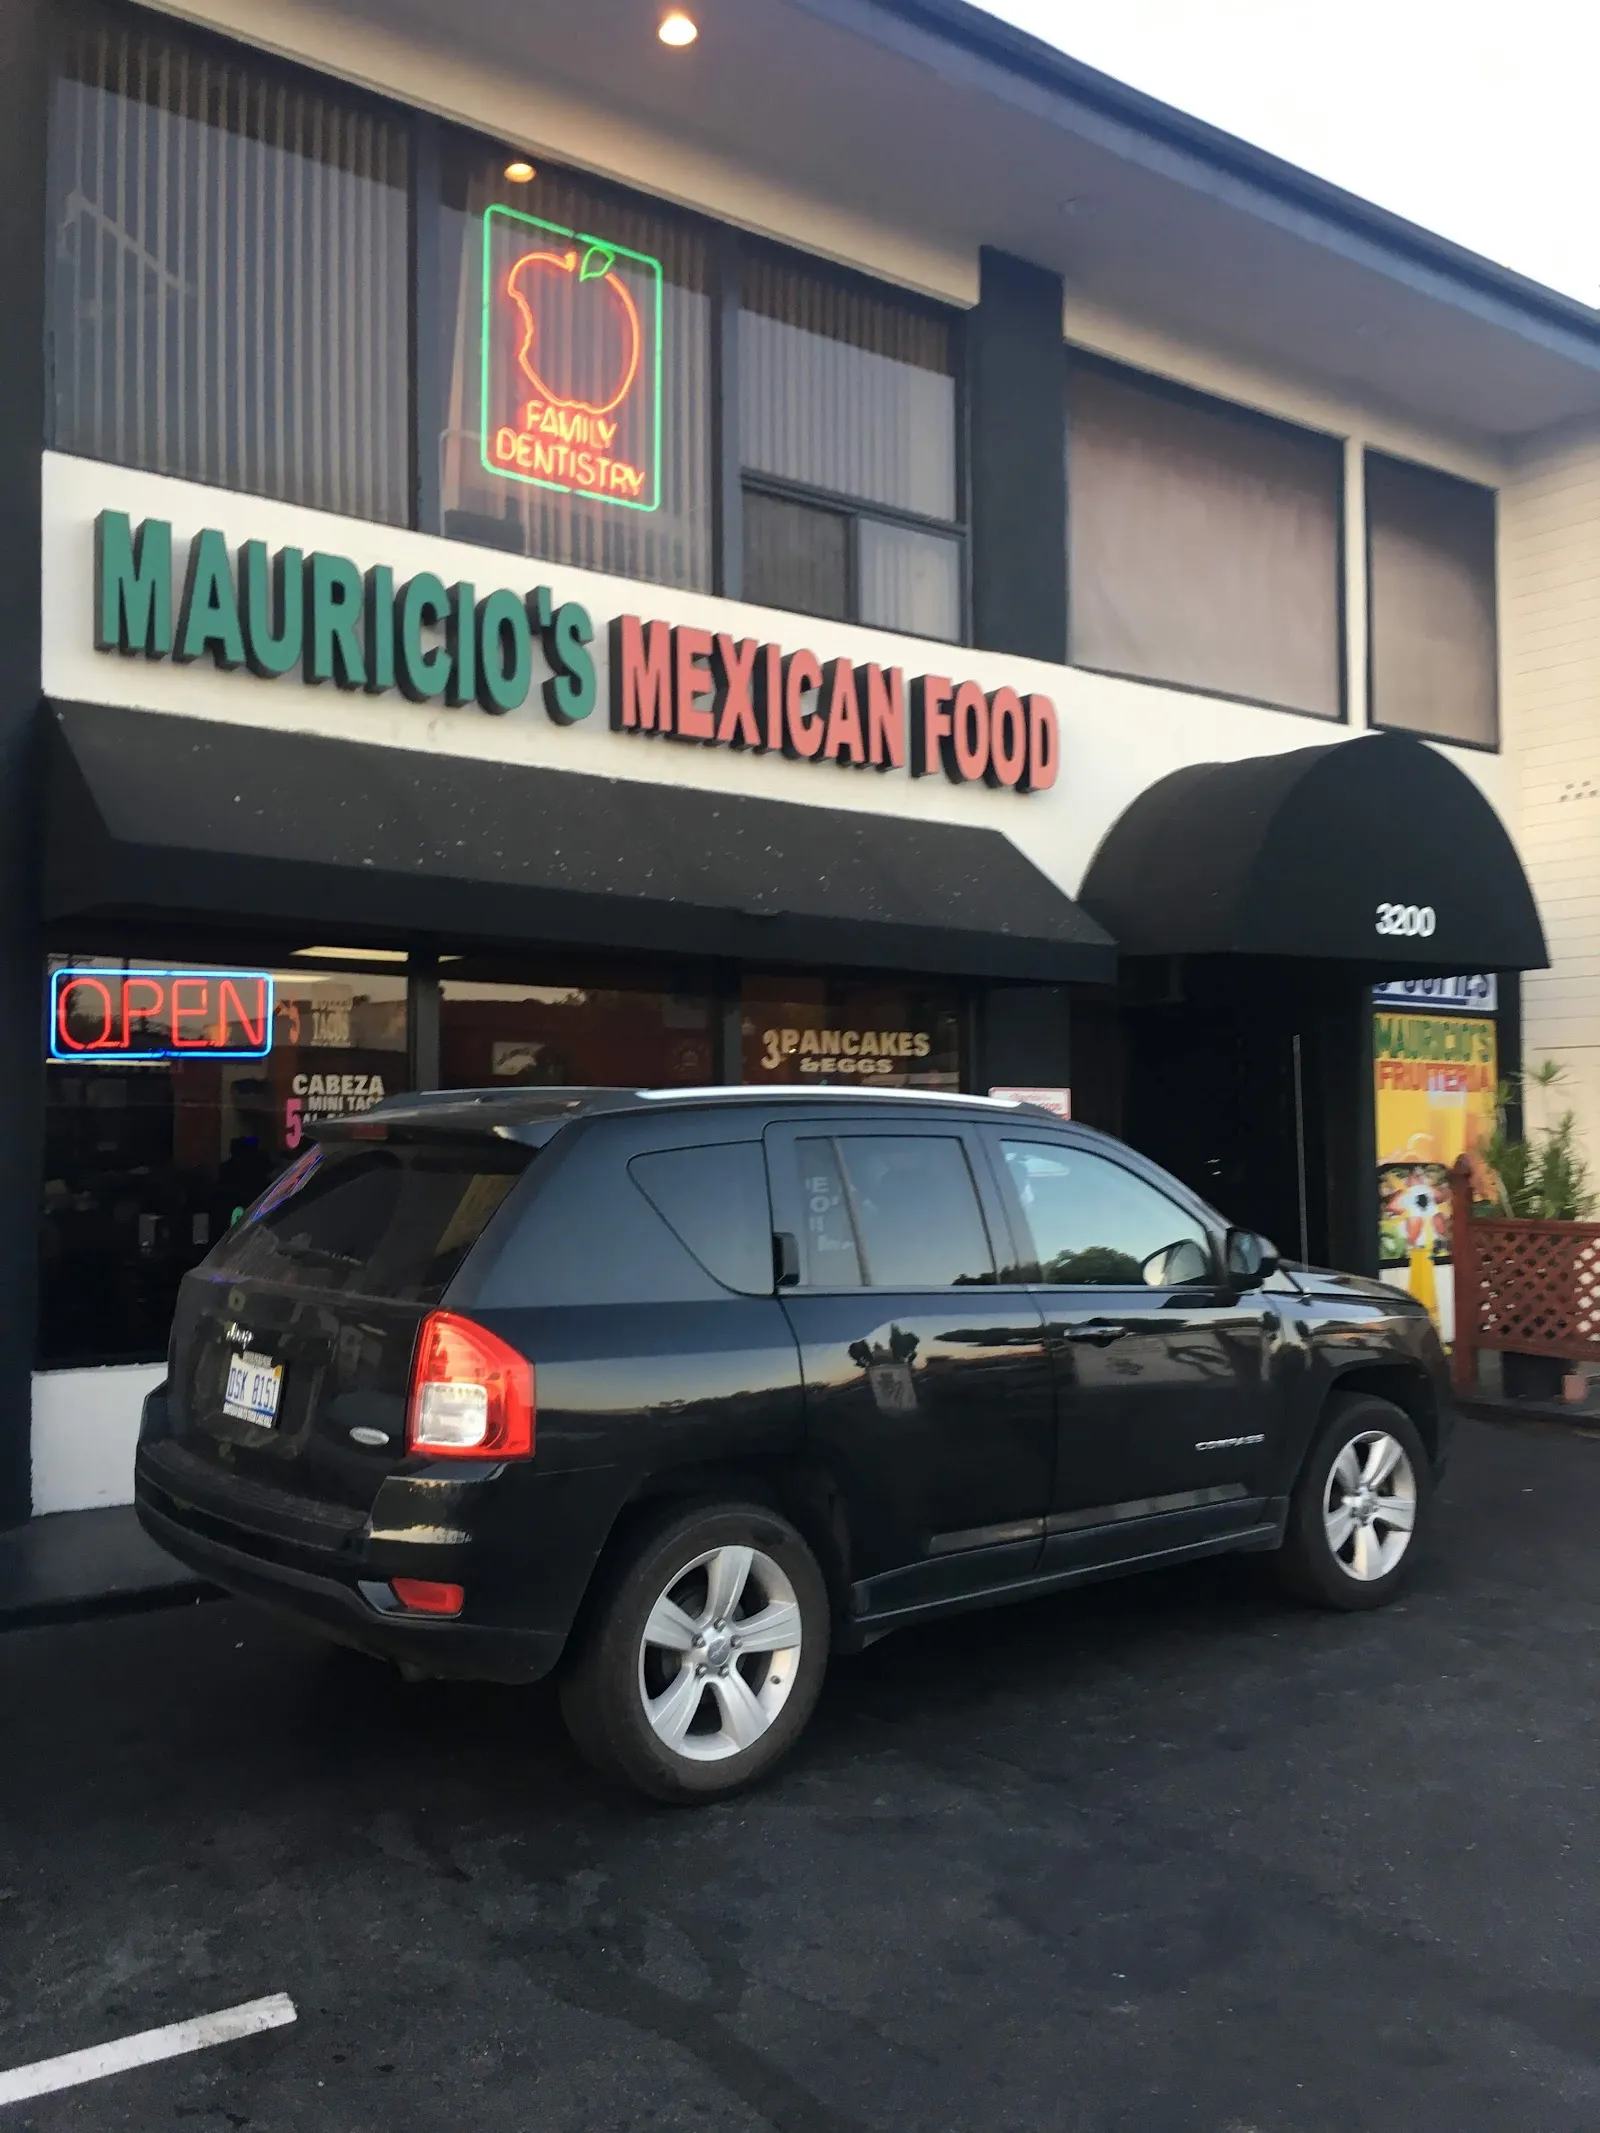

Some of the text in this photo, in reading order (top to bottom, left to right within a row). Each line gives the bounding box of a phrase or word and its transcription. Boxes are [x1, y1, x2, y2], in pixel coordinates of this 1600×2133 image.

[526, 399, 618, 449] FAMILY
[496, 426, 645, 496] DENTISTRY
[94, 509, 1059, 793] MAURICIO'S MEXICAN FOOD
[1375, 902, 1436, 937] 3200
[58, 976, 267, 1050] OPEN
[292, 1073, 385, 1096] CABEZA
[285, 1098, 303, 1149] 5
